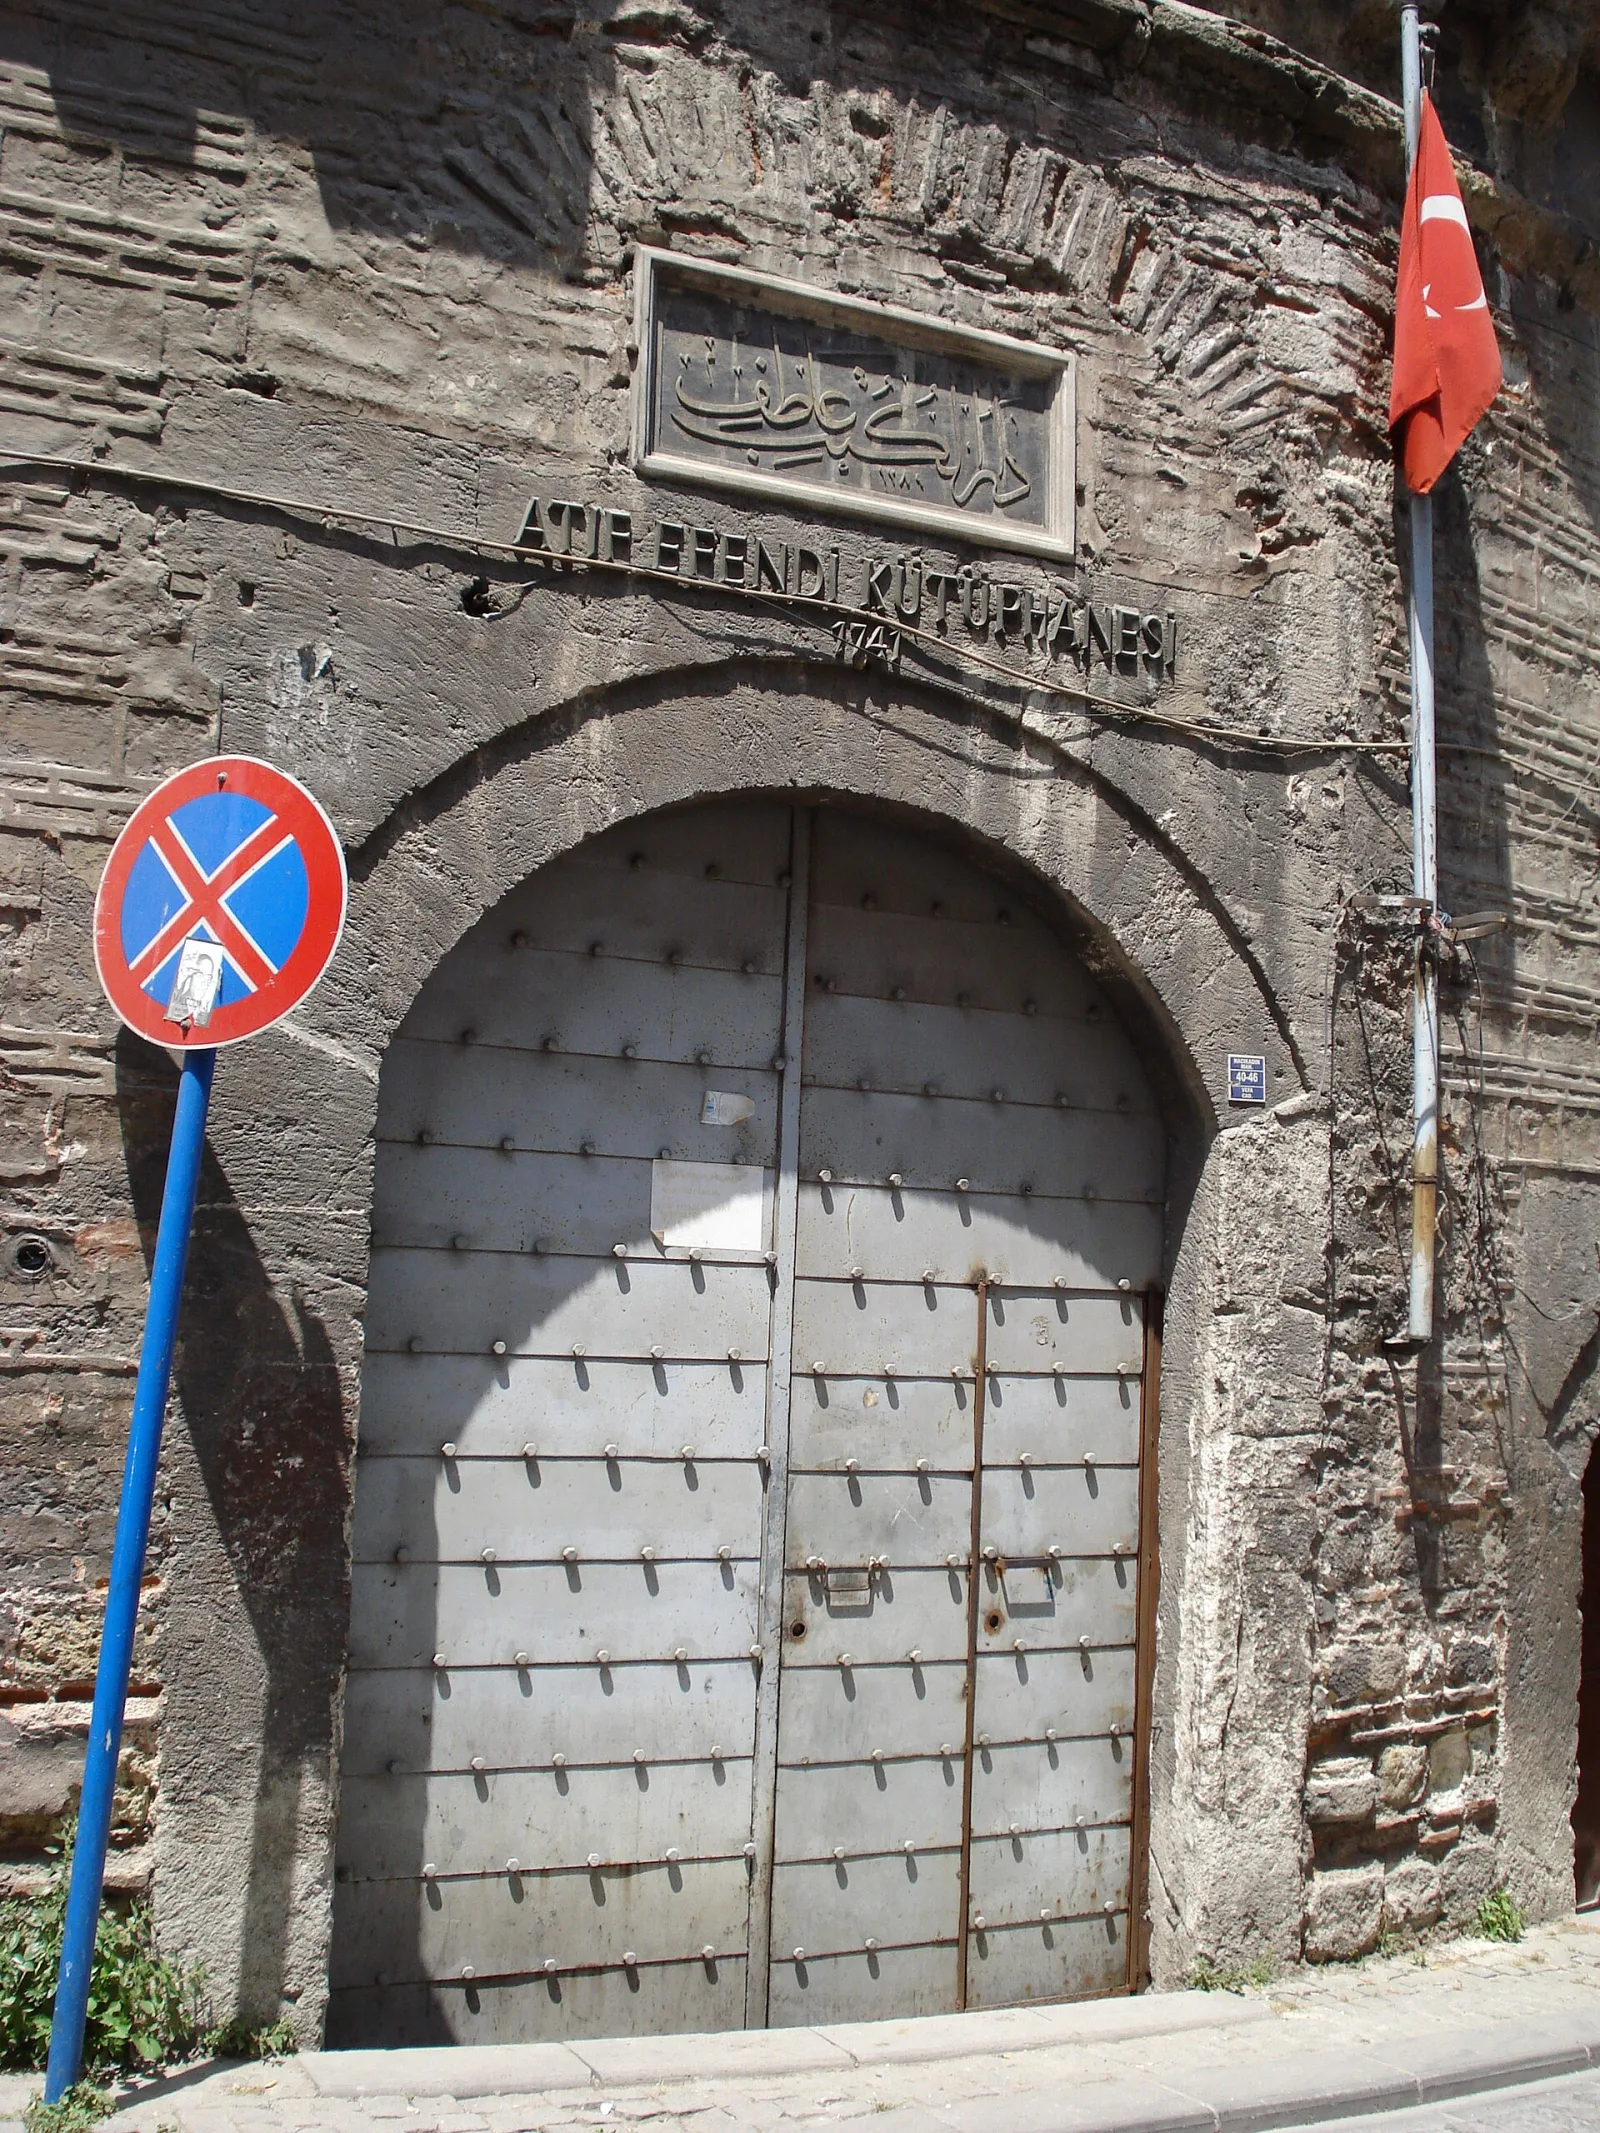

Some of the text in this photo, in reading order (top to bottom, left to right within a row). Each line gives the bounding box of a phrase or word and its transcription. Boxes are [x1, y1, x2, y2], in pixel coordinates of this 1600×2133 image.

[512, 496, 1177, 666] ATIF EFENDİ KÜTÜPHANESİ
[830, 620, 901, 667] 1741
[1236, 1071, 1259, 1083] 40-46
